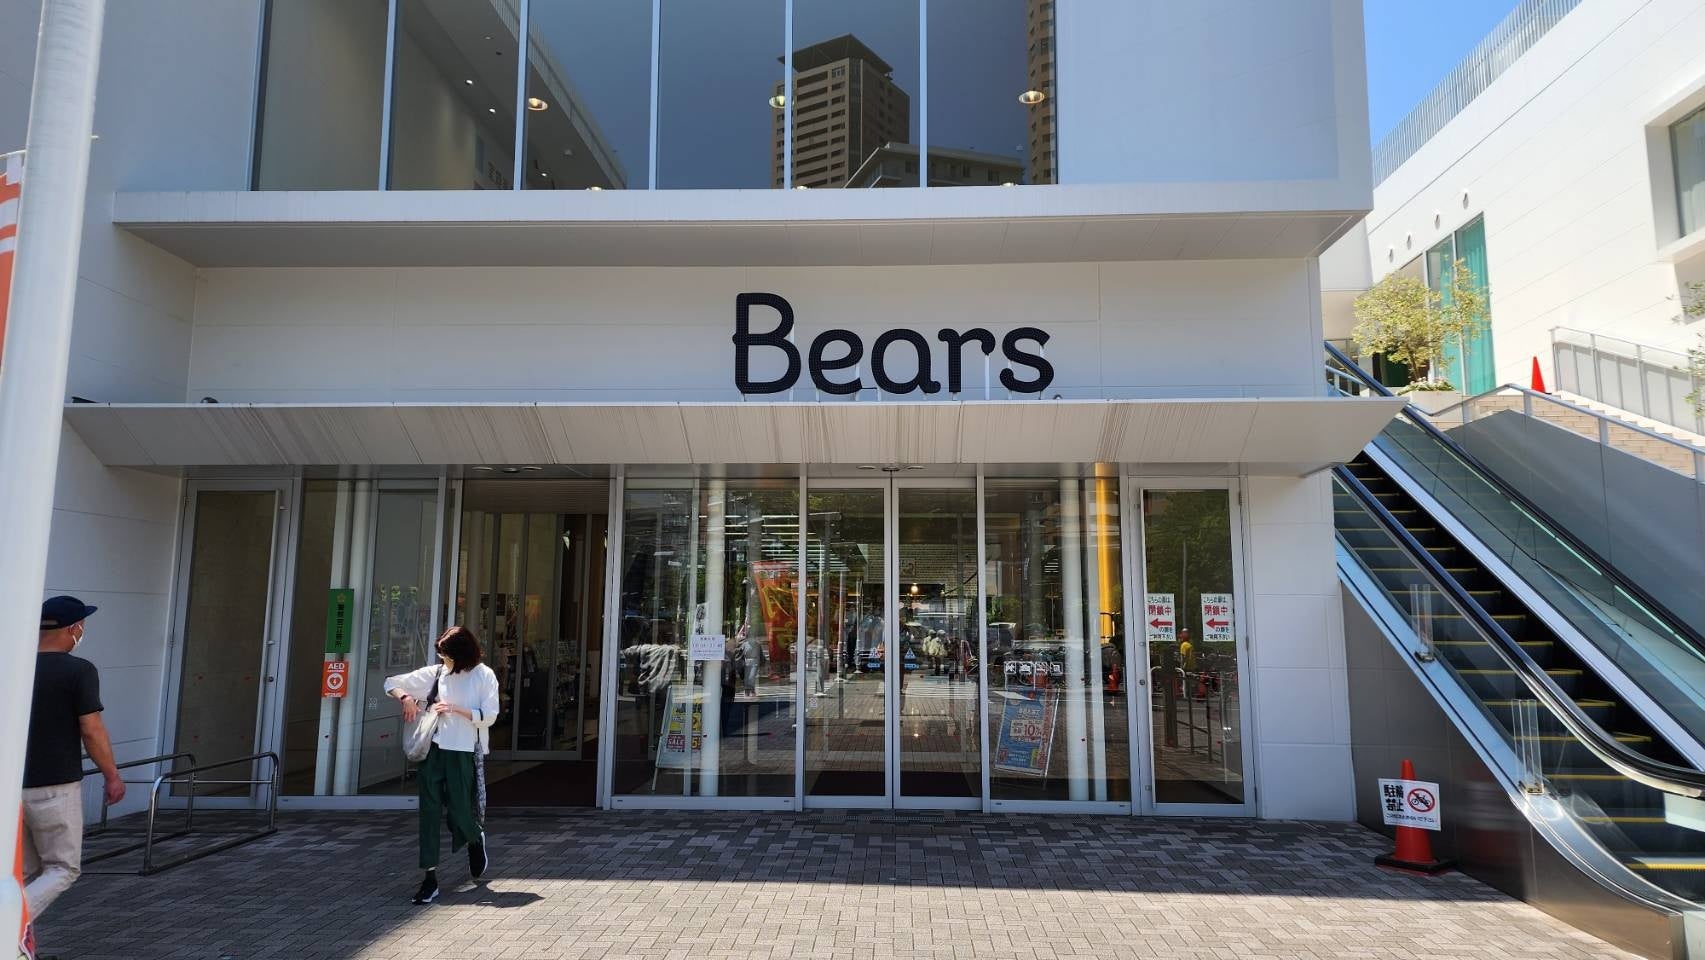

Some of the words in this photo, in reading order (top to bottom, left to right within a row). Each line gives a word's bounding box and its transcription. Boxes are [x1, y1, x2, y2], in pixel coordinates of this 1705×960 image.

[732, 292, 1055, 395] Bears
[1148, 604, 1172, 616] 閉鎖中
[1204, 604, 1228, 616] 閉鎖中
[327, 662, 345, 670] AED
[1383, 784, 1404, 798] 駐輪
[1385, 798, 1405, 812] 禁止
